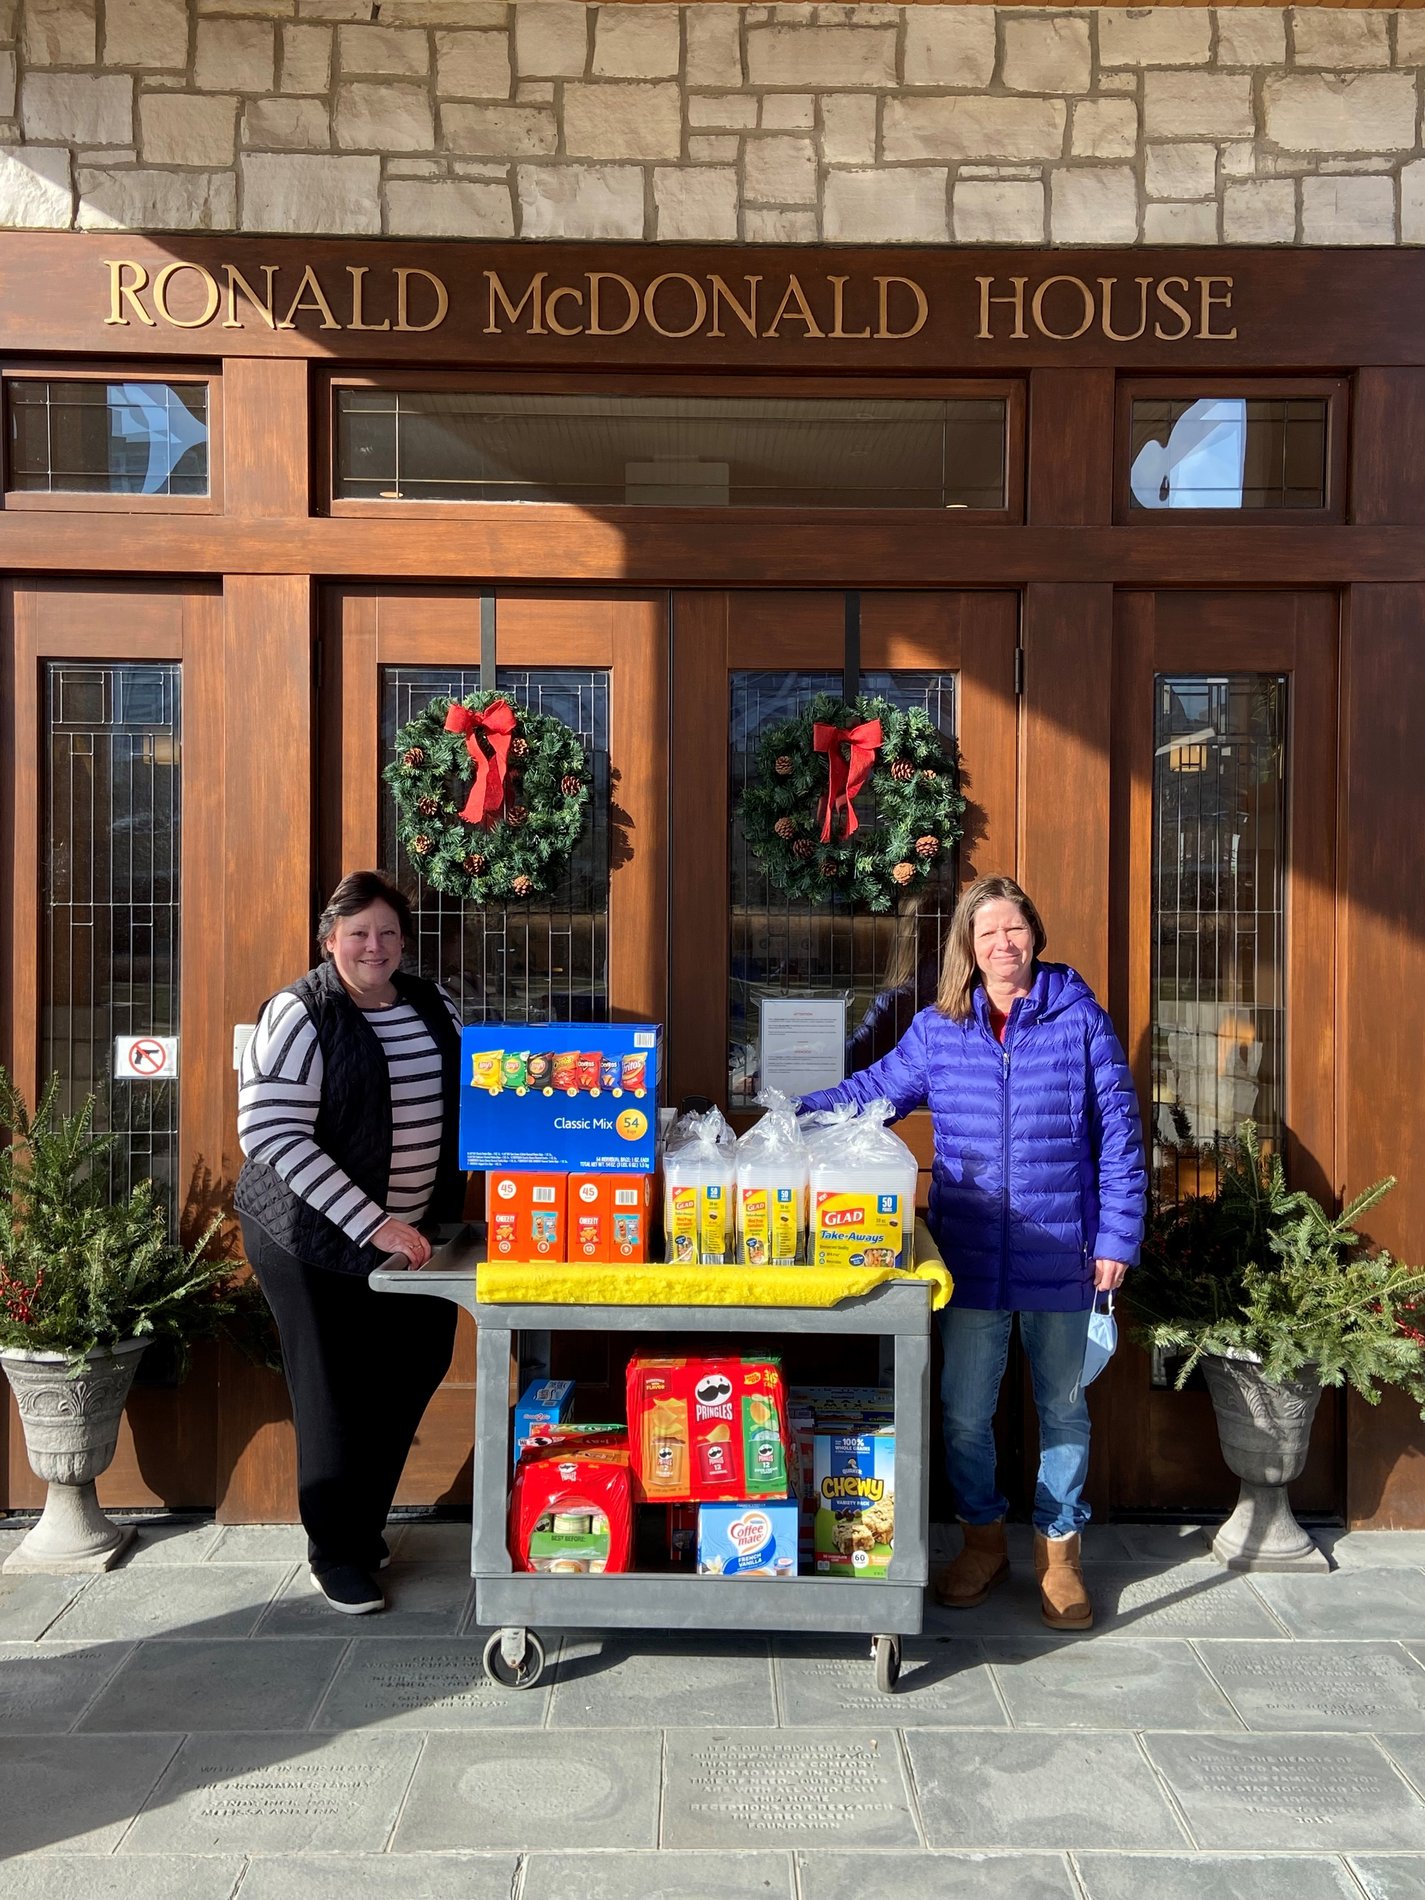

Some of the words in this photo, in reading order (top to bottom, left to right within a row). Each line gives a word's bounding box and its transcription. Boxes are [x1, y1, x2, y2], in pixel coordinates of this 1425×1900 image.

[104, 260, 448, 332] RONALD
[483, 270, 929, 338] McDONALD
[975, 275, 1237, 341] HOUSE
[554, 1117, 591, 1130] Classic
[593, 1118, 613, 1130] Mix
[624, 1117, 640, 1128] 54
[501, 1184, 513, 1194] 45
[582, 1187, 595, 1197] 45
[781, 1190, 789, 1198] 50
[676, 1201, 694, 1209] GLAD
[747, 1203, 765, 1211] GLAD
[882, 1196, 893, 1208] 50
[824, 1211, 863, 1226] GLAD
[820, 1230, 884, 1243] Take-Aways
[696, 1404, 733, 1422] PRINGLES
[842, 1438, 865, 1447] 100%
[730, 1522, 764, 1540] Coffee
[738, 1533, 762, 1546] mate
[738, 1553, 762, 1563] FRENCH
[739, 1558, 762, 1568] VANILLA
[855, 1554, 865, 1562] 60
